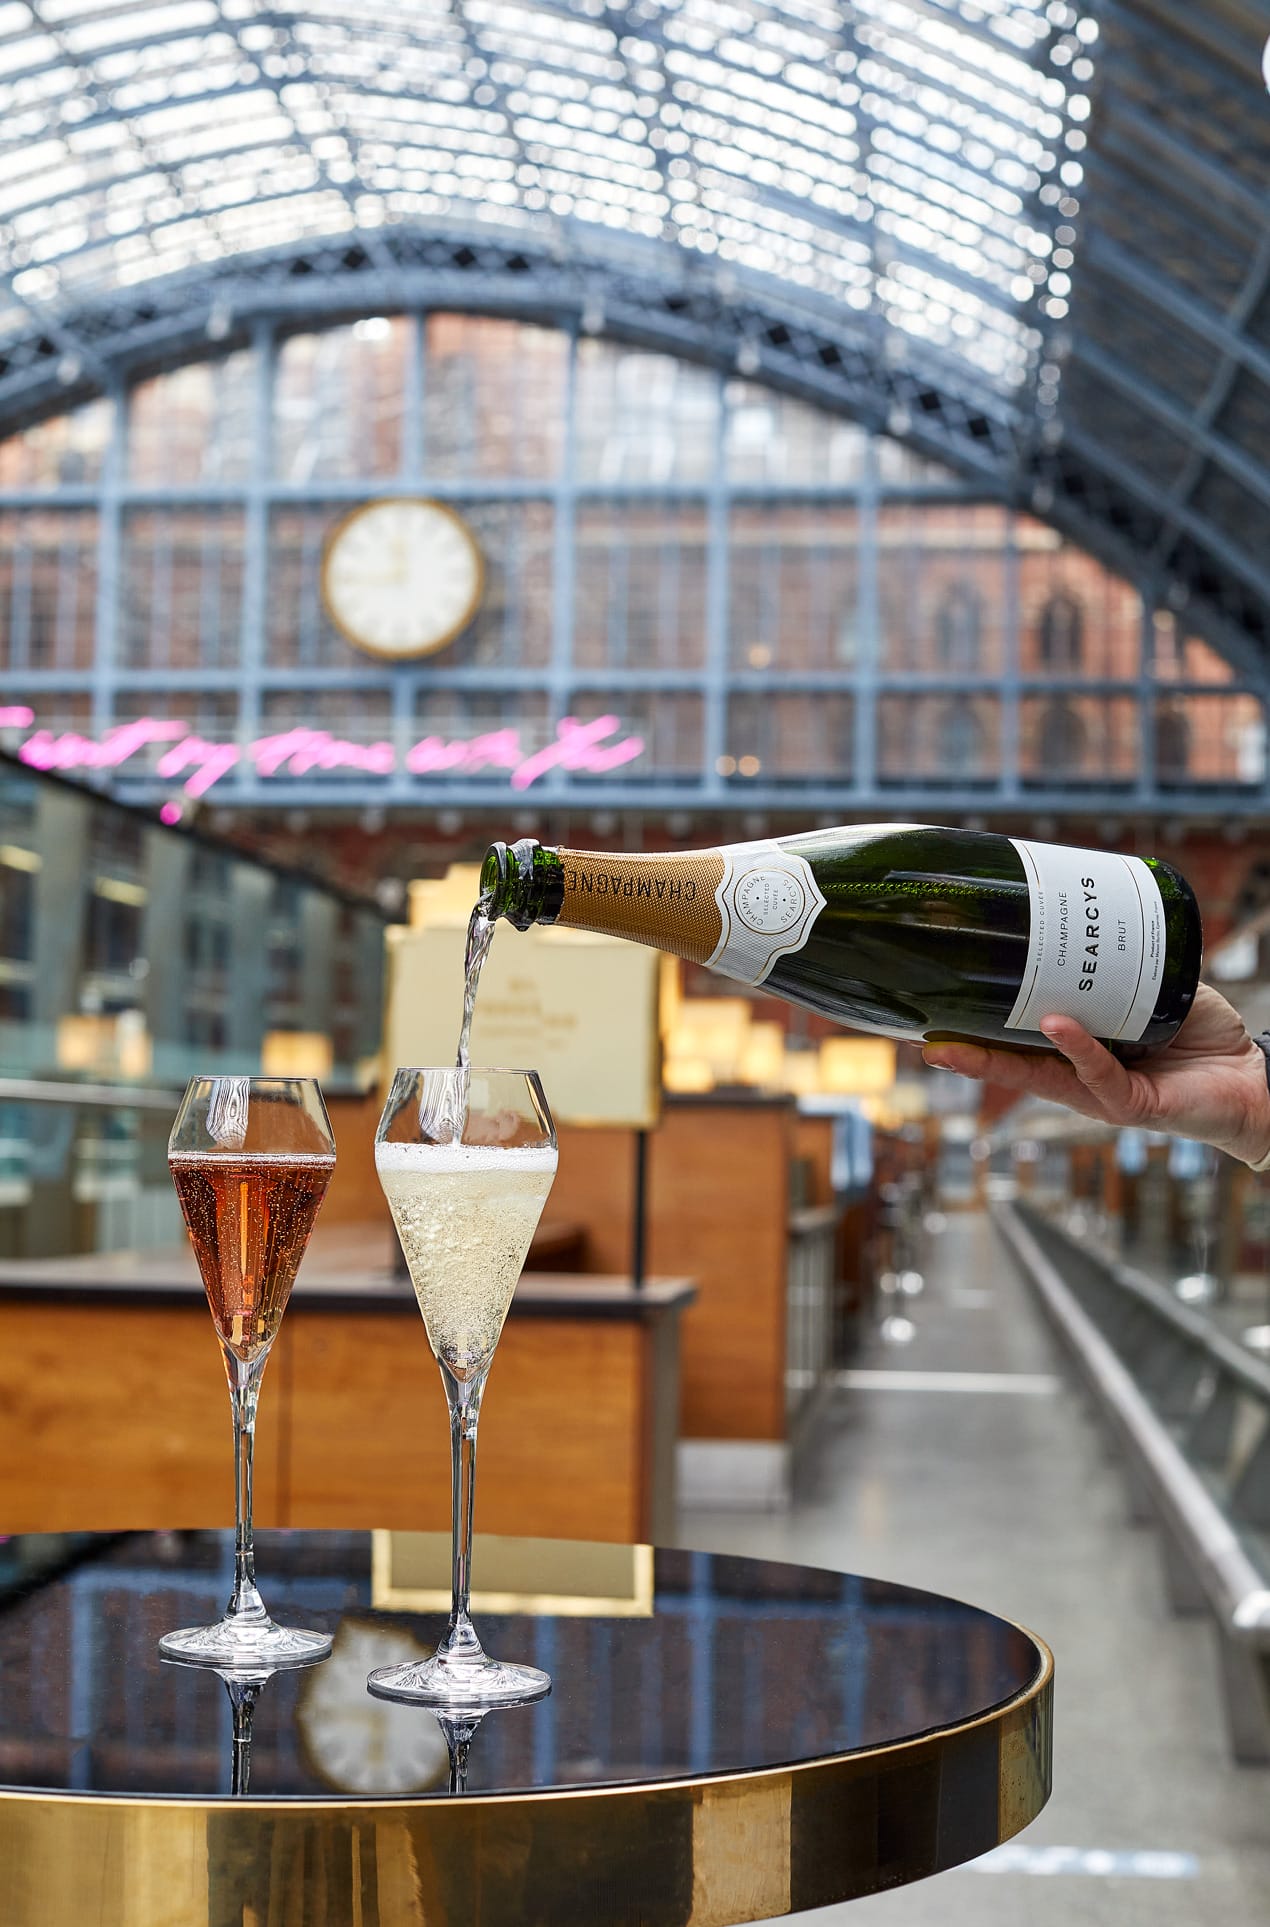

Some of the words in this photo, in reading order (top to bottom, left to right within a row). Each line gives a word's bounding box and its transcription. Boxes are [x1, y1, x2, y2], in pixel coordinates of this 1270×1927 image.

[567, 870, 697, 902] CHAMPAGNE
[741, 876, 766, 926] CHAMPAGNE
[780, 879, 798, 923] SEARCYS
[1036, 920, 1045, 962] SELECTED
[1057, 891, 1069, 967] CHAMPAGNE
[1079, 877, 1100, 992] SEARCYS
[1117, 920, 1127, 951] BRUT
